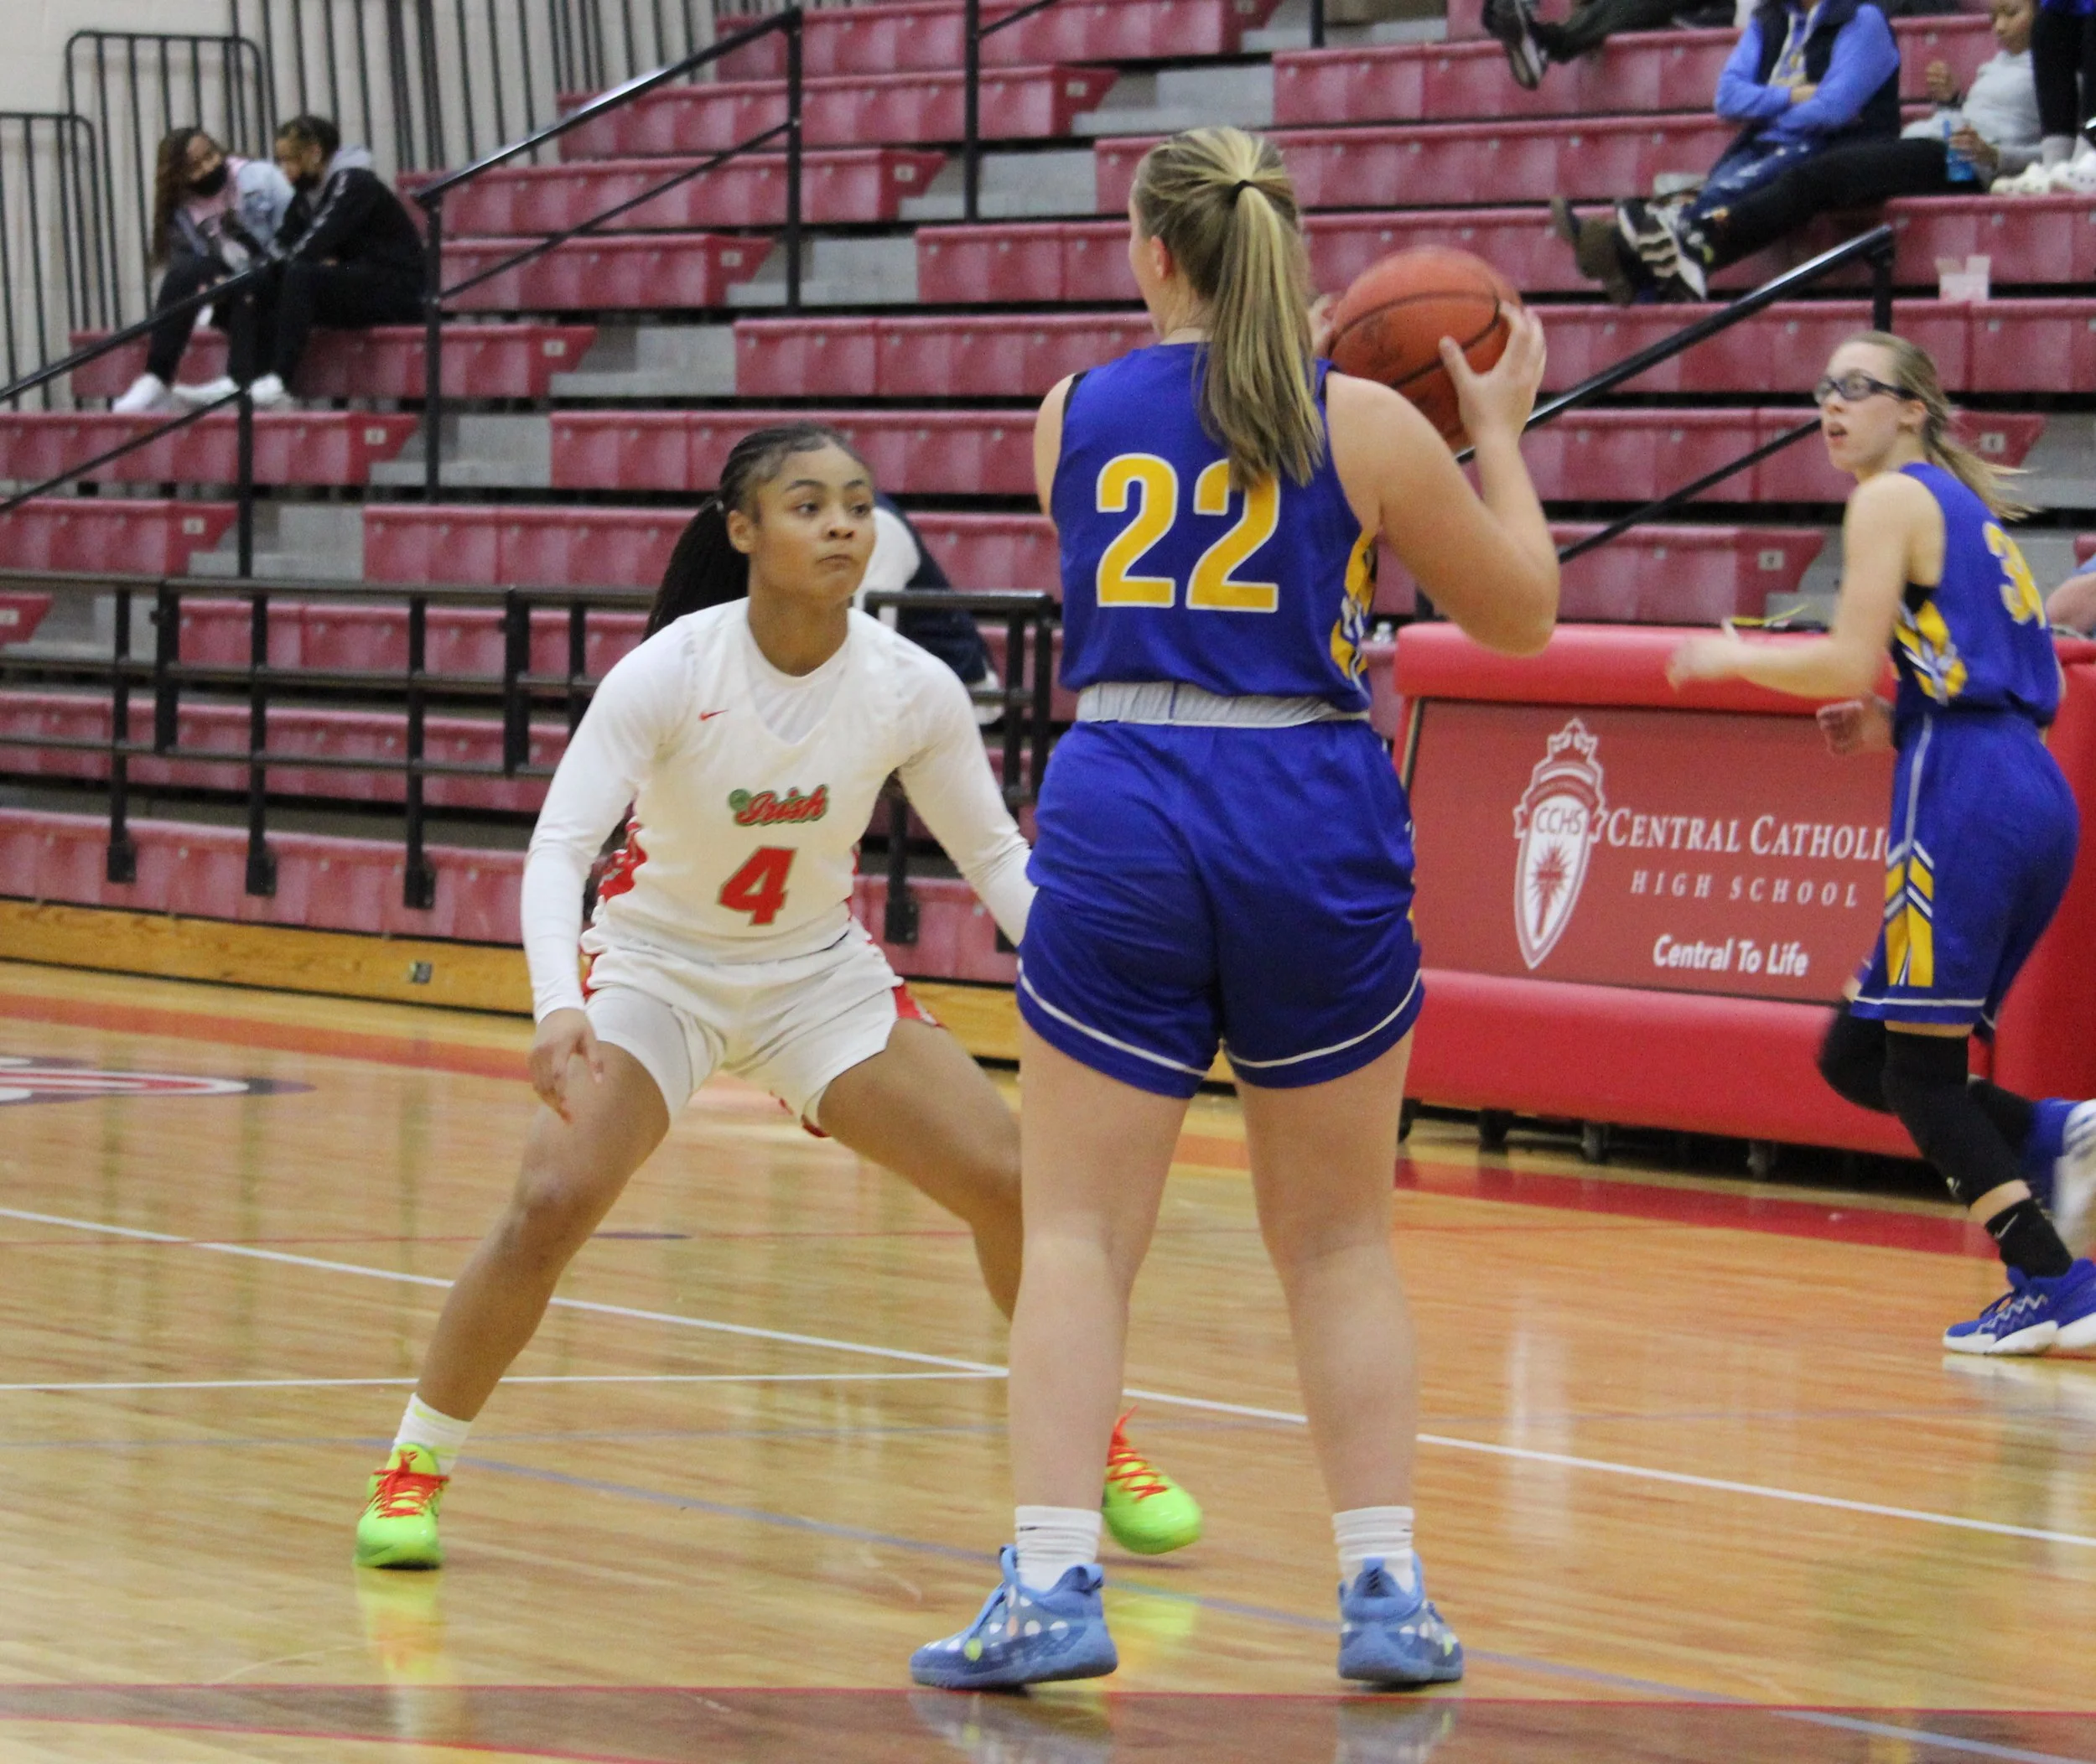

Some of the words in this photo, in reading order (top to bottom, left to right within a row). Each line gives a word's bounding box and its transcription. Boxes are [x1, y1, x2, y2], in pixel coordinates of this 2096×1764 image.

[1096, 452, 1280, 614] 22
[734, 783, 828, 827] Irish
[1535, 807, 1583, 835] CCHS
[1606, 807, 1741, 853] CENTRAL
[1750, 815, 1889, 861] CATHOLI
[716, 845, 797, 926] 4
[1630, 870, 1713, 898] HIGH
[1729, 876, 1857, 908] SCHOOL
[1652, 933, 1734, 971] Central
[1737, 939, 1762, 973] To
[1766, 941, 1810, 977] Life
